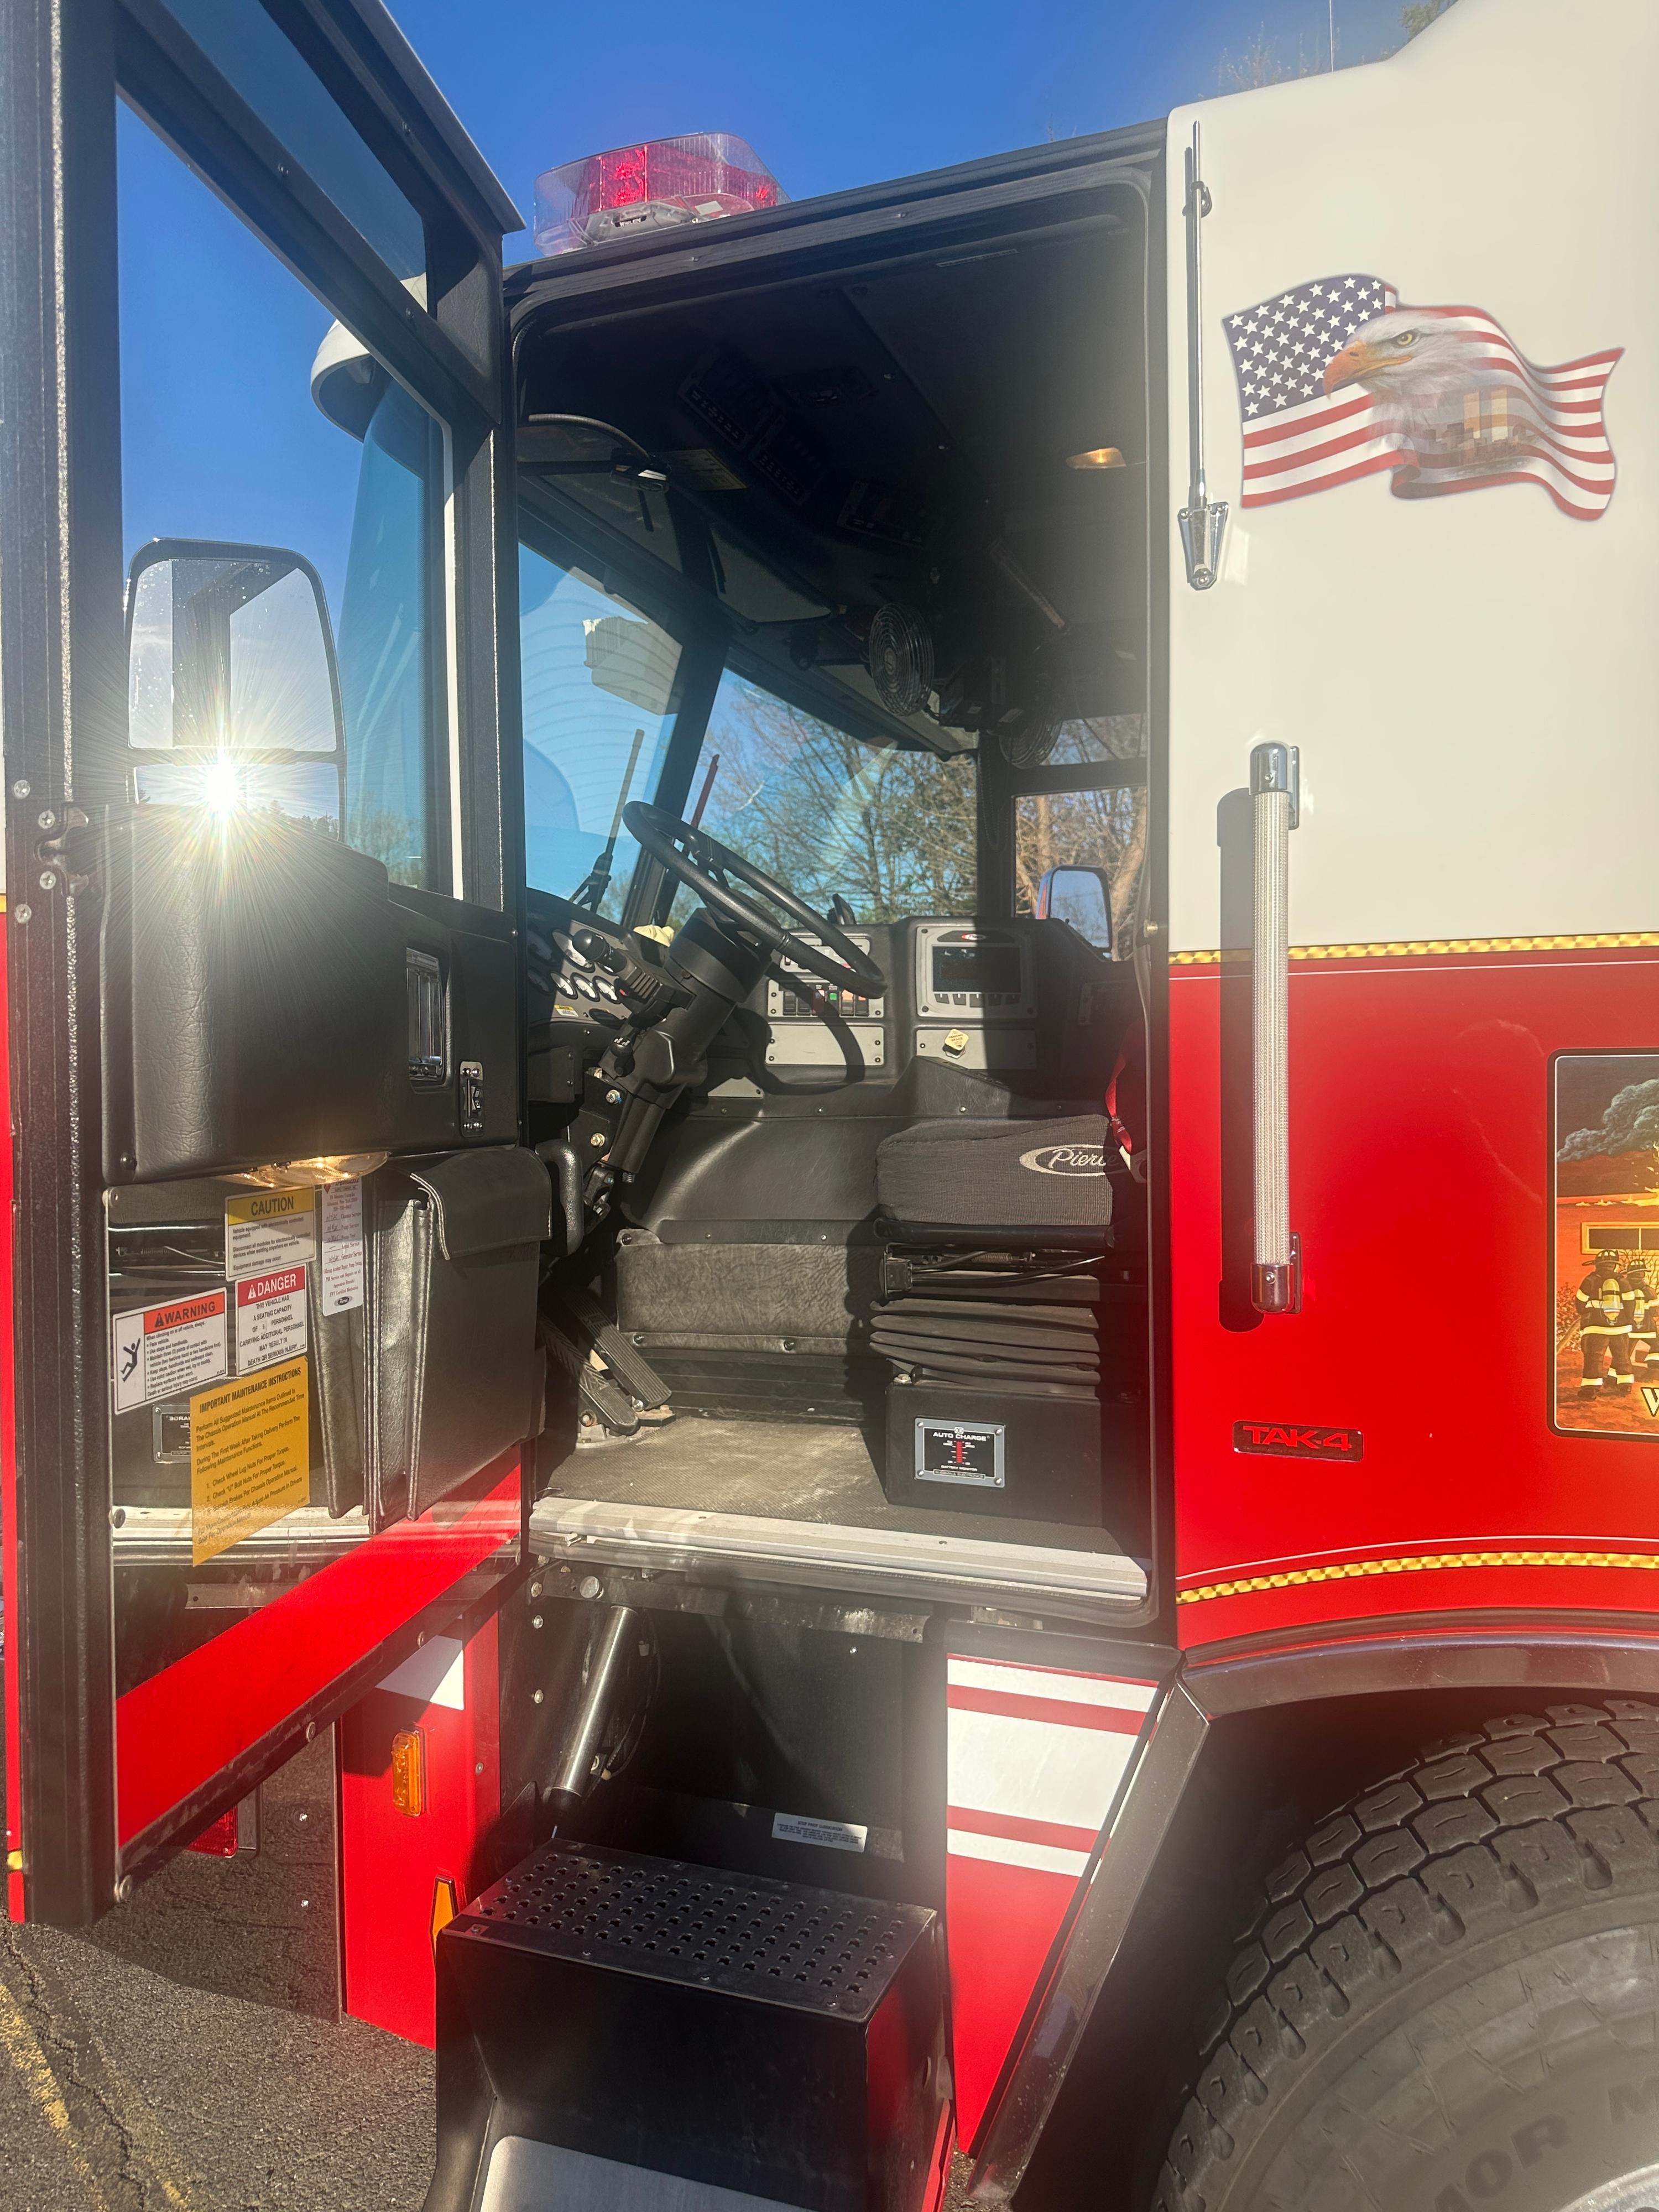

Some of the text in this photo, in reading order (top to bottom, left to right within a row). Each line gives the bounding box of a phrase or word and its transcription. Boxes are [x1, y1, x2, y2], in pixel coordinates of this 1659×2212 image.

[1048, 1149, 1119, 1169] Pierce
[251, 1197, 294, 1215] CAUTION
[258, 1275, 296, 1295] DANGER
[257, 1311, 273, 1319] SEATING
[274, 1305, 292, 1314] CAPACITY
[265, 1298, 281, 1306] VEHICLE
[164, 1302, 215, 1324] WARNING
[272, 1314, 293, 1326] PERSONNEL
[240, 1322, 304, 1347] CARRYING ADDITIONAL PERSONNEL
[268, 1339, 282, 1348] RESULT
[248, 1357, 260, 1366] DEATH
[268, 1349, 284, 1359] SERIOUS
[200, 1368, 301, 1413] IMPORTANT MAINTENANCE INSTRUCTIONS
[196, 1421, 212, 1433] Perform
[220, 1410, 241, 1425] Suggested
[242, 1400, 265, 1415] Maintenance
[266, 1396, 276, 1405] Items
[276, 1389, 291, 1401] Outlined
[205, 1427, 221, 1439] Chassis
[223, 1418, 241, 1432] Operation
[242, 1413, 255, 1423] Manual
[269, 1397, 295, 1412] Recommended
[196, 1454, 211, 1467] During
[229, 1441, 241, 1451] Week
[242, 1437, 251, 1446] After
[252, 1431, 263, 1442] Taking
[264, 1425, 278, 1437] Delivery
[279, 1418, 293, 1429] Perform
[1243, 1425, 1352, 1453] TAK-4
[212, 1476, 225, 1487] Check
[226, 1469, 238, 1480] Wheel
[247, 1461, 256, 1470] Nuts
[264, 1451, 276, 1463] Proper
[213, 1488, 226, 1500] Check
[243, 1475, 252, 1485] Nuts
[260, 1466, 272, 1477] Proper
[251, 1481, 265, 1493] Chassis
[267, 1472, 283, 1486] Operation
